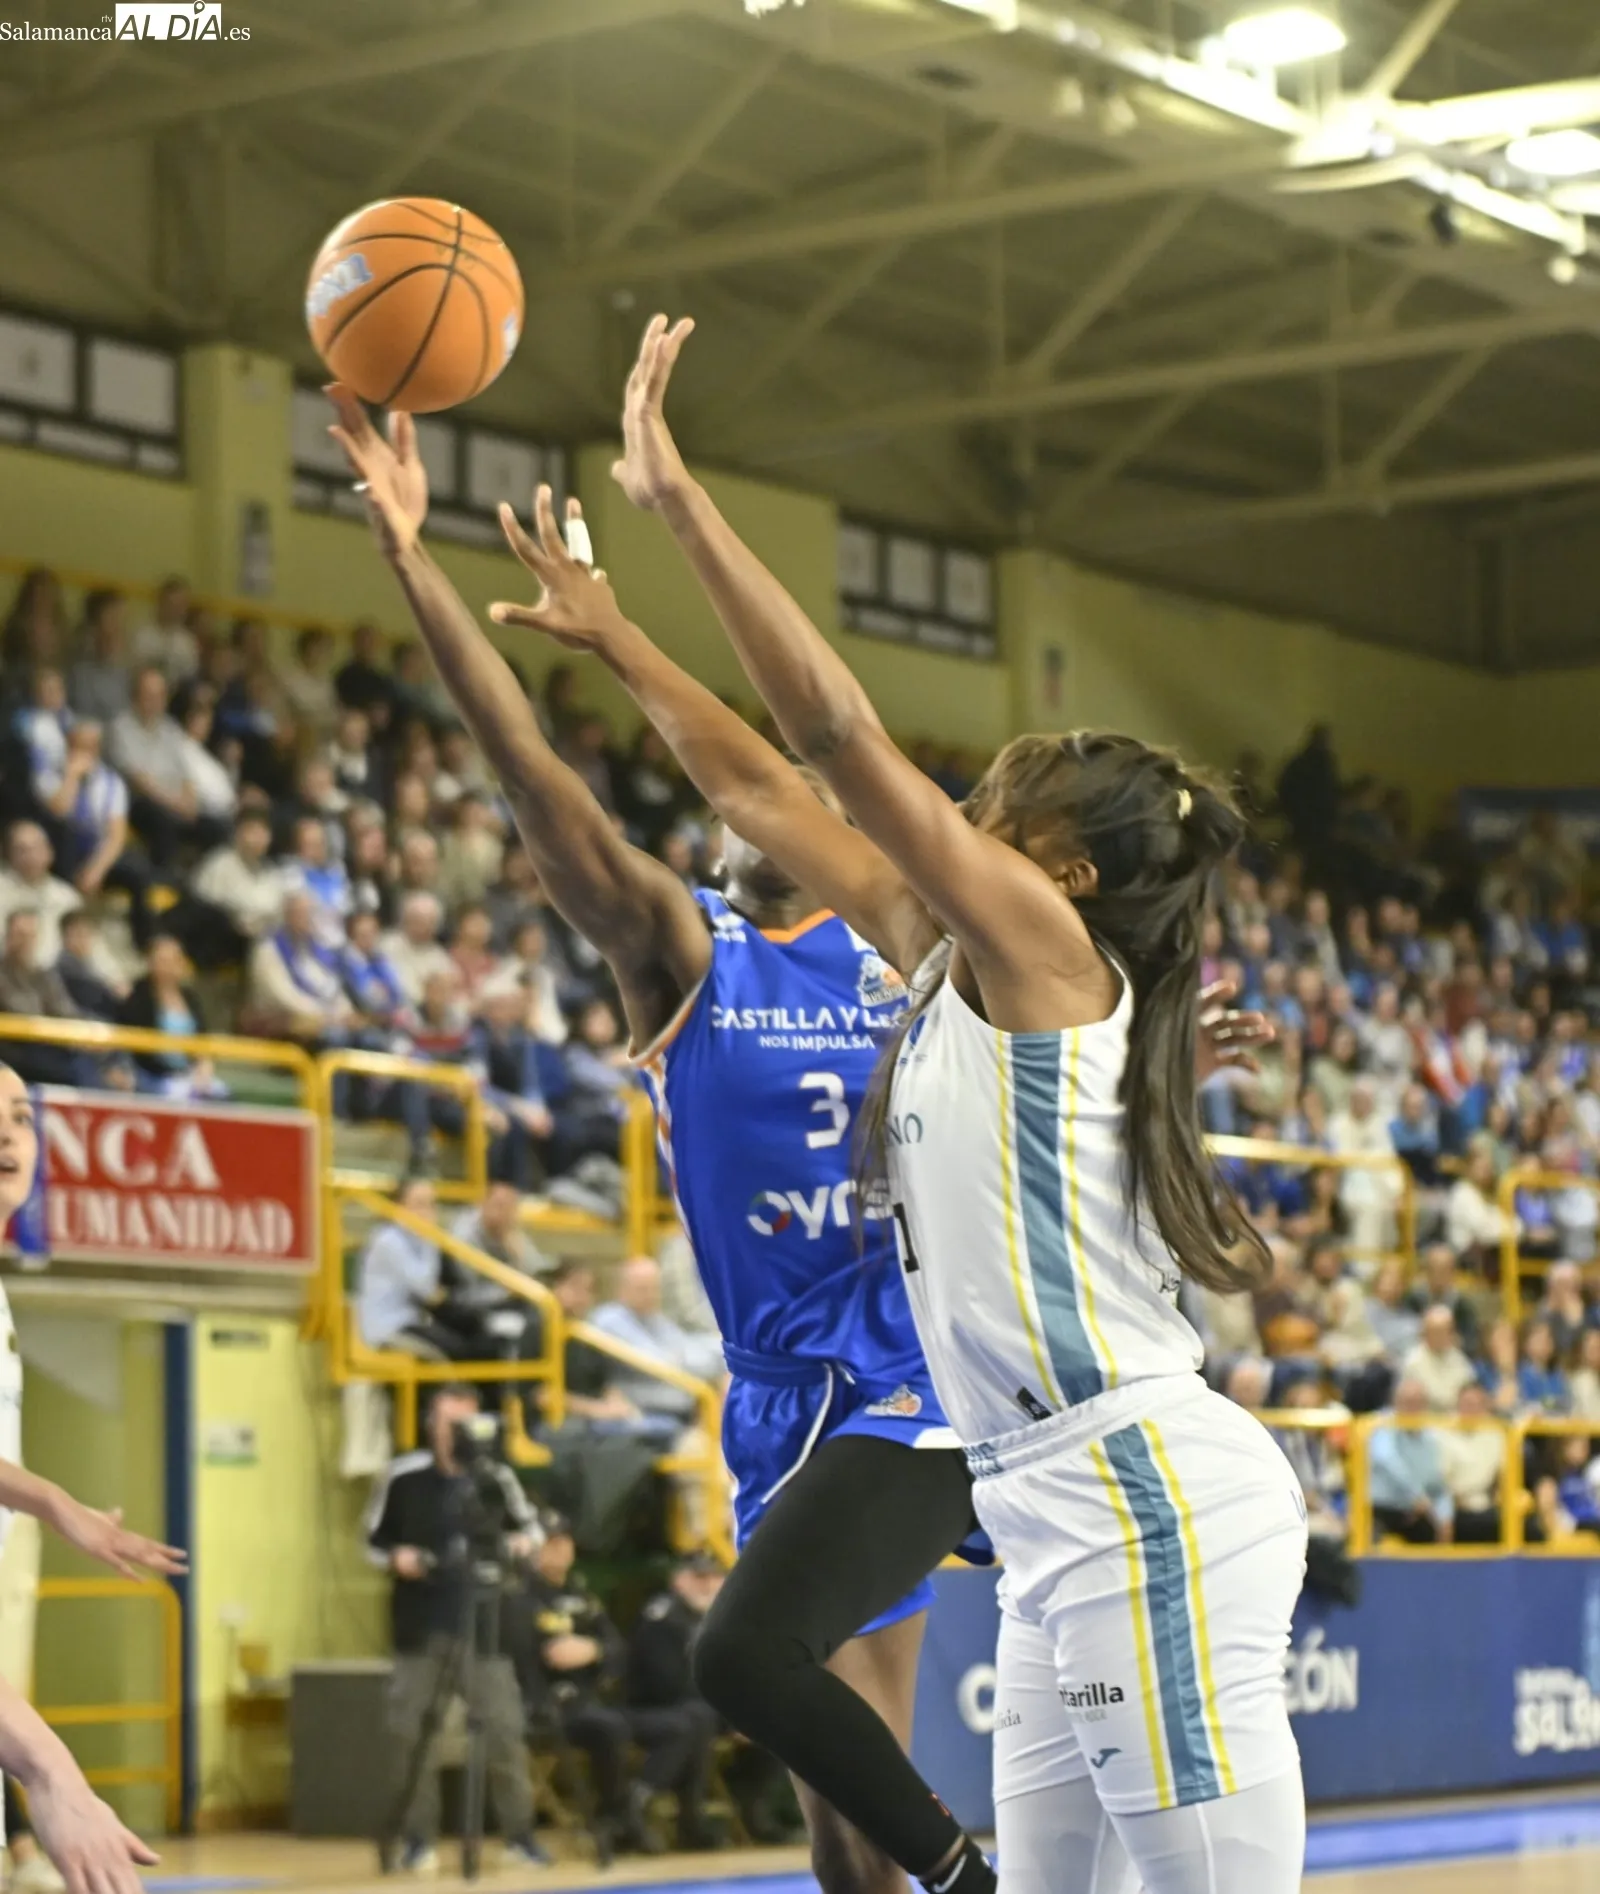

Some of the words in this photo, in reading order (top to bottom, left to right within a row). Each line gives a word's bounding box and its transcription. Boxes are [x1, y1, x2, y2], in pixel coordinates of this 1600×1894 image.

[712, 1005, 836, 1030] CASTILLA
[837, 1006, 858, 1032] Y
[760, 1035, 789, 1049] NOS
[793, 1034, 876, 1052] IMPULSA
[799, 1072, 849, 1149] 3
